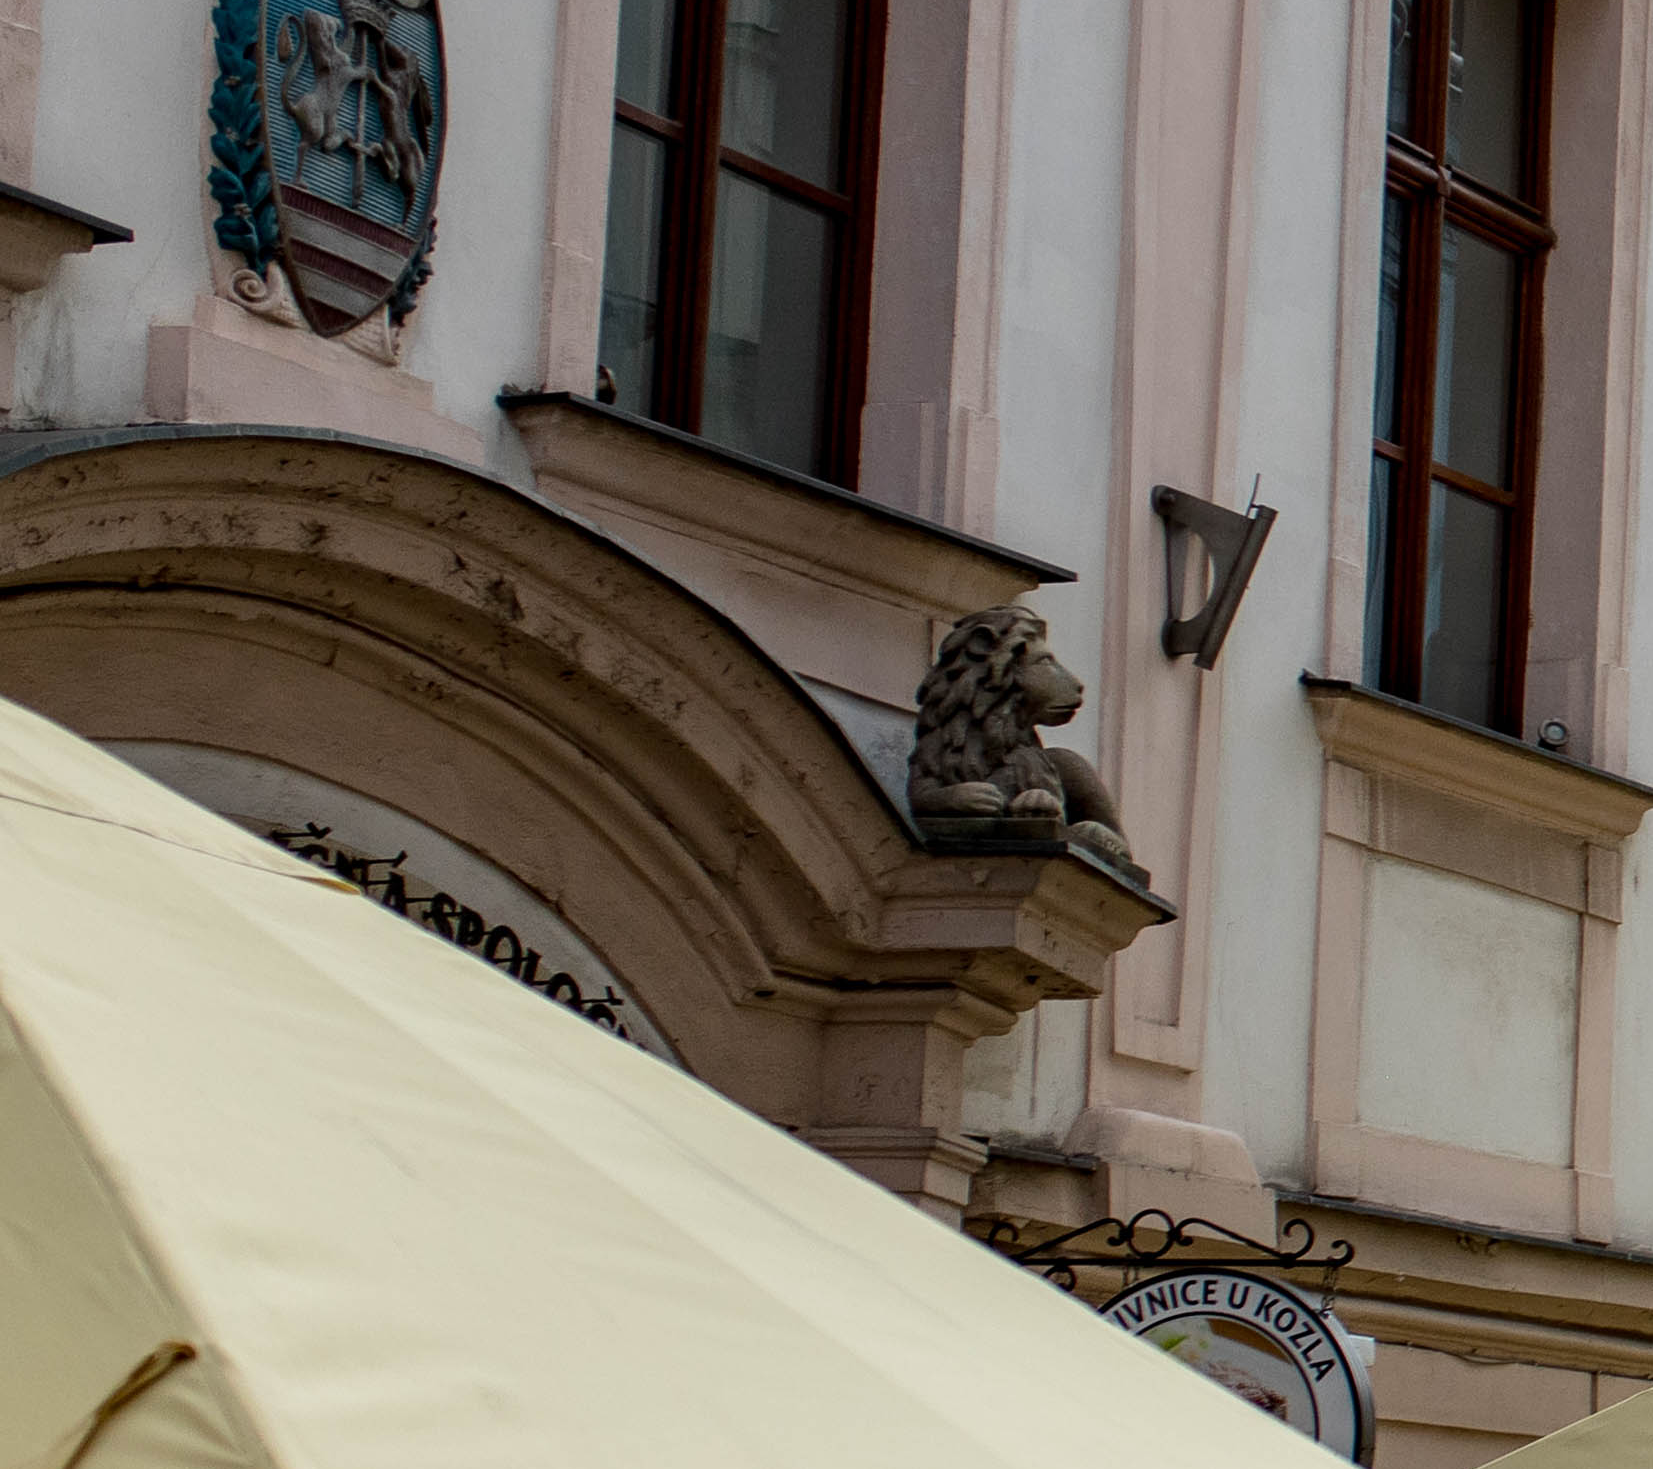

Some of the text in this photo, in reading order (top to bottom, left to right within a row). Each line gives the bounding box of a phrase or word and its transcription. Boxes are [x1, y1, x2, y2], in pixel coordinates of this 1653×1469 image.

[1112, 1279, 1337, 1383] IVNICE U KOZLA
